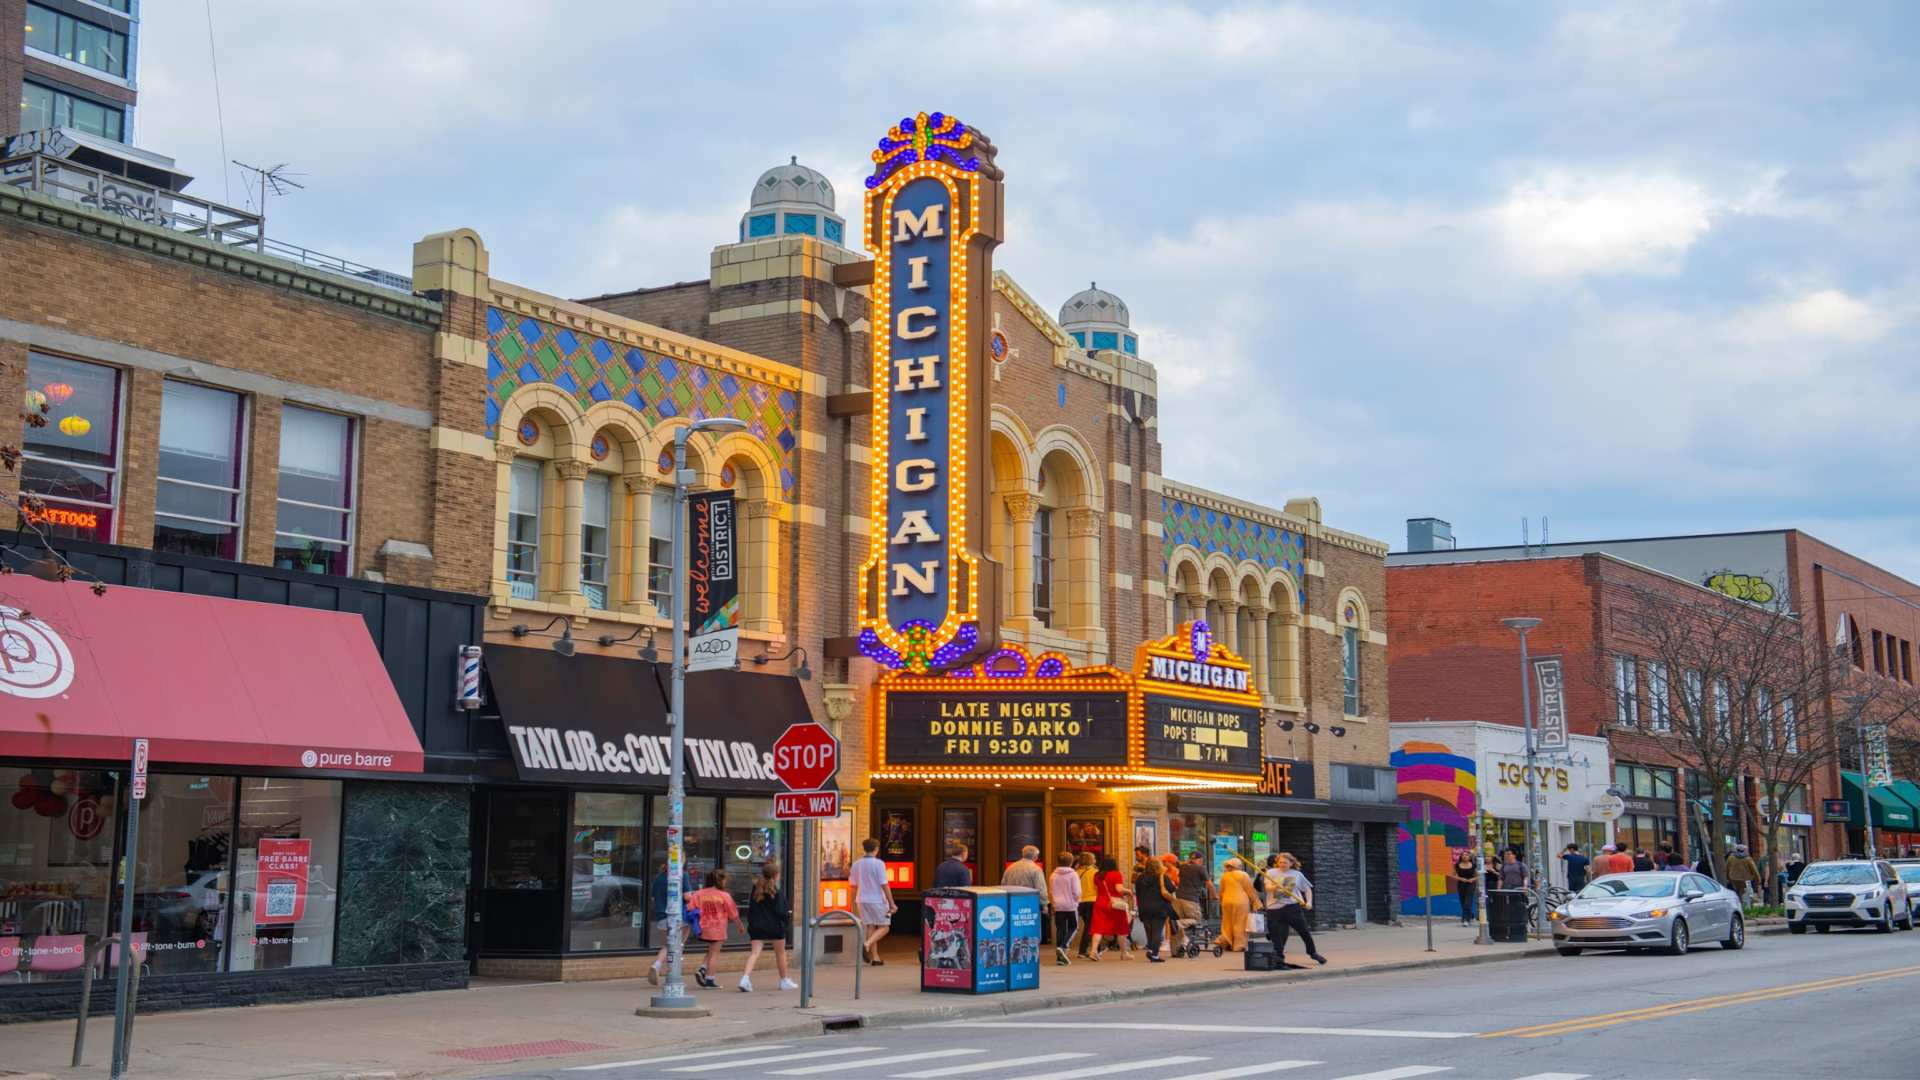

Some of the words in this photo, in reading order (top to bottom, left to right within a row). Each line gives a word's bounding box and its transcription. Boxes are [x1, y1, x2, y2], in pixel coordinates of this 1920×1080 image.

[891, 204, 943, 596] MICHIGAN
[715, 505, 728, 576] DISTRICT
[688, 498, 709, 613] welcome
[1151, 656, 1248, 691] MICHIGAN
[941, 703, 990, 717] LATE
[1000, 703, 1072, 718] NIGHTS
[1541, 664, 1561, 744] DISTRICT
[1170, 707, 1214, 726] MICHIGAN
[1217, 713, 1240, 729] POPS
[930, 721, 1003, 736] DONNIE
[1012, 721, 1081, 736] DARKO
[1163, 724, 1187, 741] POPS
[947, 739, 979, 754] FRI
[989, 739, 1032, 754] 9:30
[1042, 739, 1070, 754] PM
[1206, 747, 1212, 761] 7
[1215, 748, 1228, 762] PM
[320, 753, 352, 767] pure
[355, 752, 391, 767] barre
[777, 744, 833, 770] STOP
[777, 798, 800, 814] ALL
[809, 796, 834, 813] WAY
